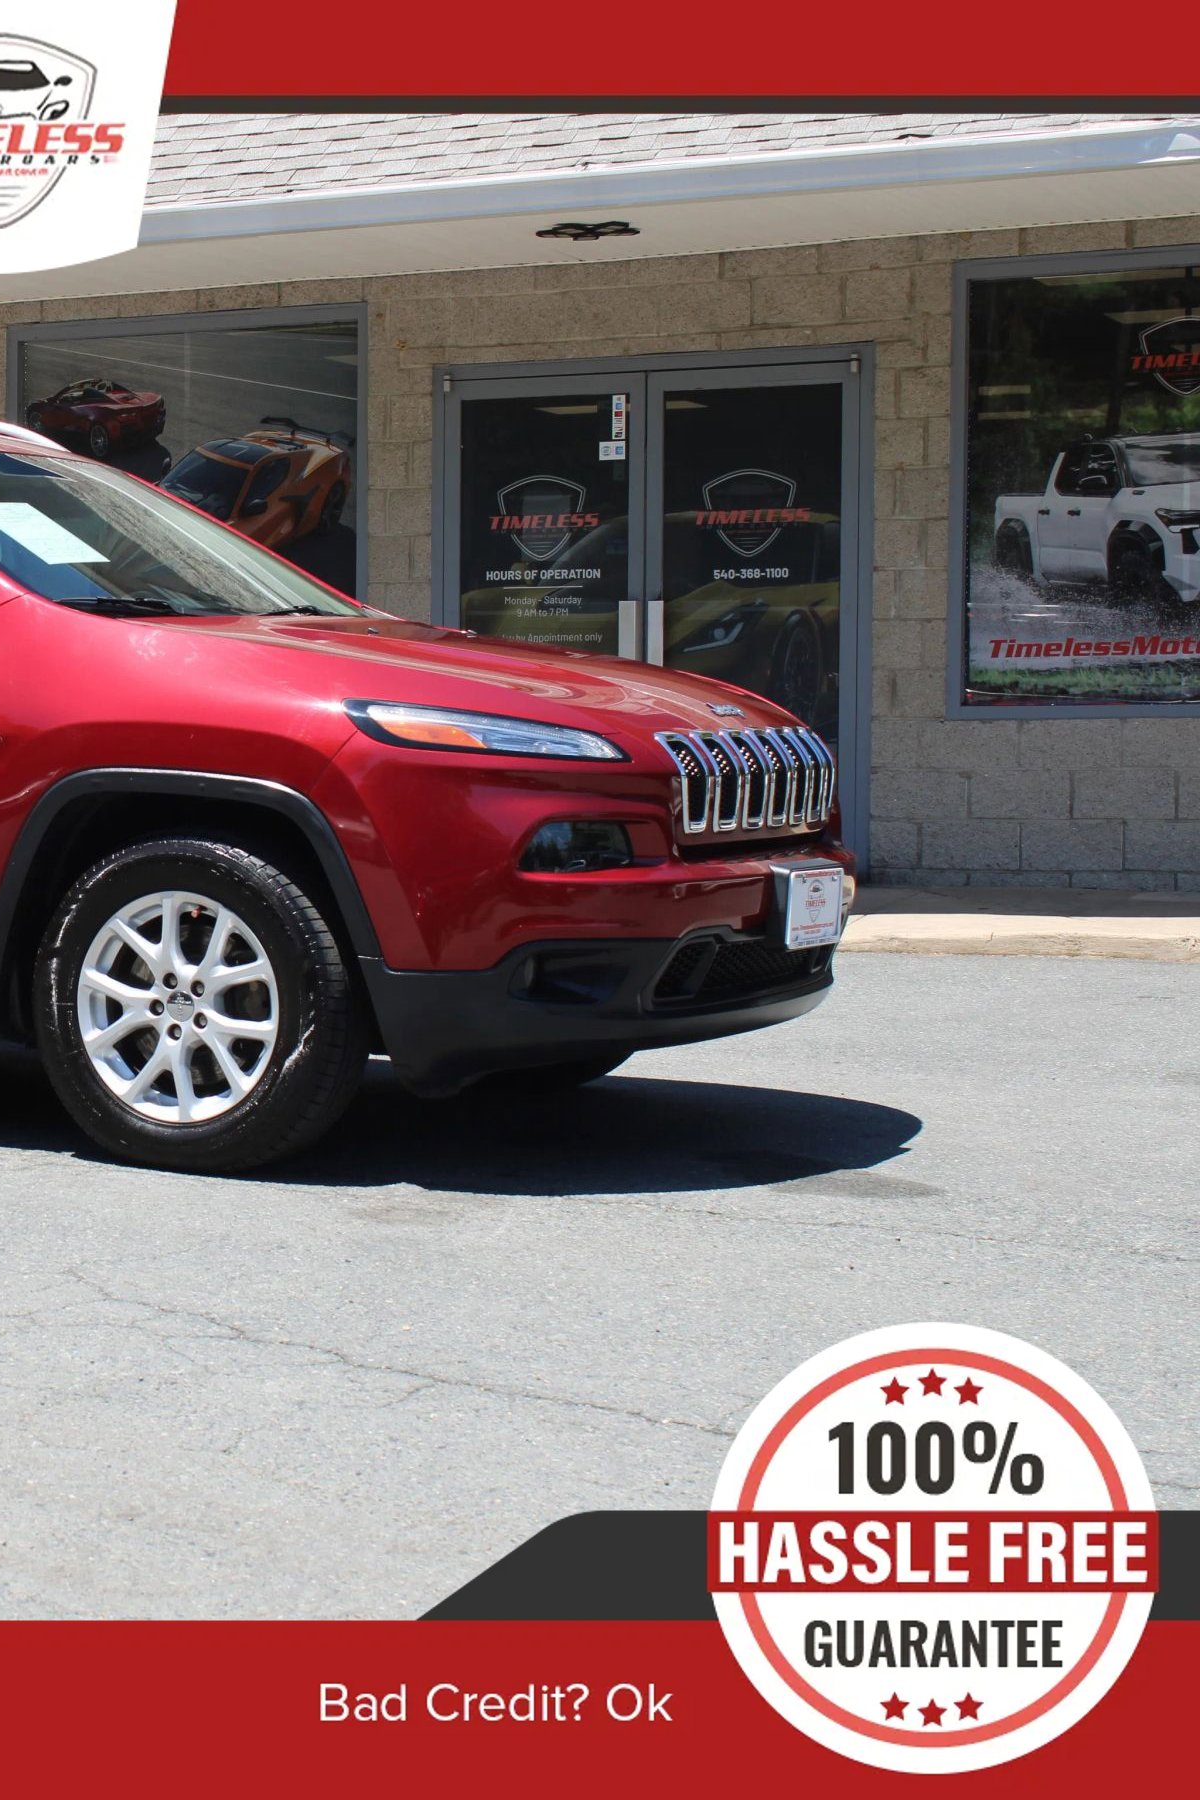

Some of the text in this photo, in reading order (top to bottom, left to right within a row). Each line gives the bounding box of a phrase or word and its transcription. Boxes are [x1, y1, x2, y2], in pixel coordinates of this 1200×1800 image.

[489, 512, 600, 530] TIMELESS
[694, 507, 811, 525] TIMELESS
[486, 568, 601, 581] HOURS OF OPERATION
[713, 567, 789, 580] 540-368-1100
[504, 596, 537, 606] Monday
[544, 595, 582, 606] Saturday
[523, 608, 537, 617] AM
[538, 608, 548, 616] to
[556, 608, 569, 616] PM
[527, 633, 584, 643] Appointment
[584, 632, 603, 643] only
[989, 635, 1200, 658] TimelessMot
